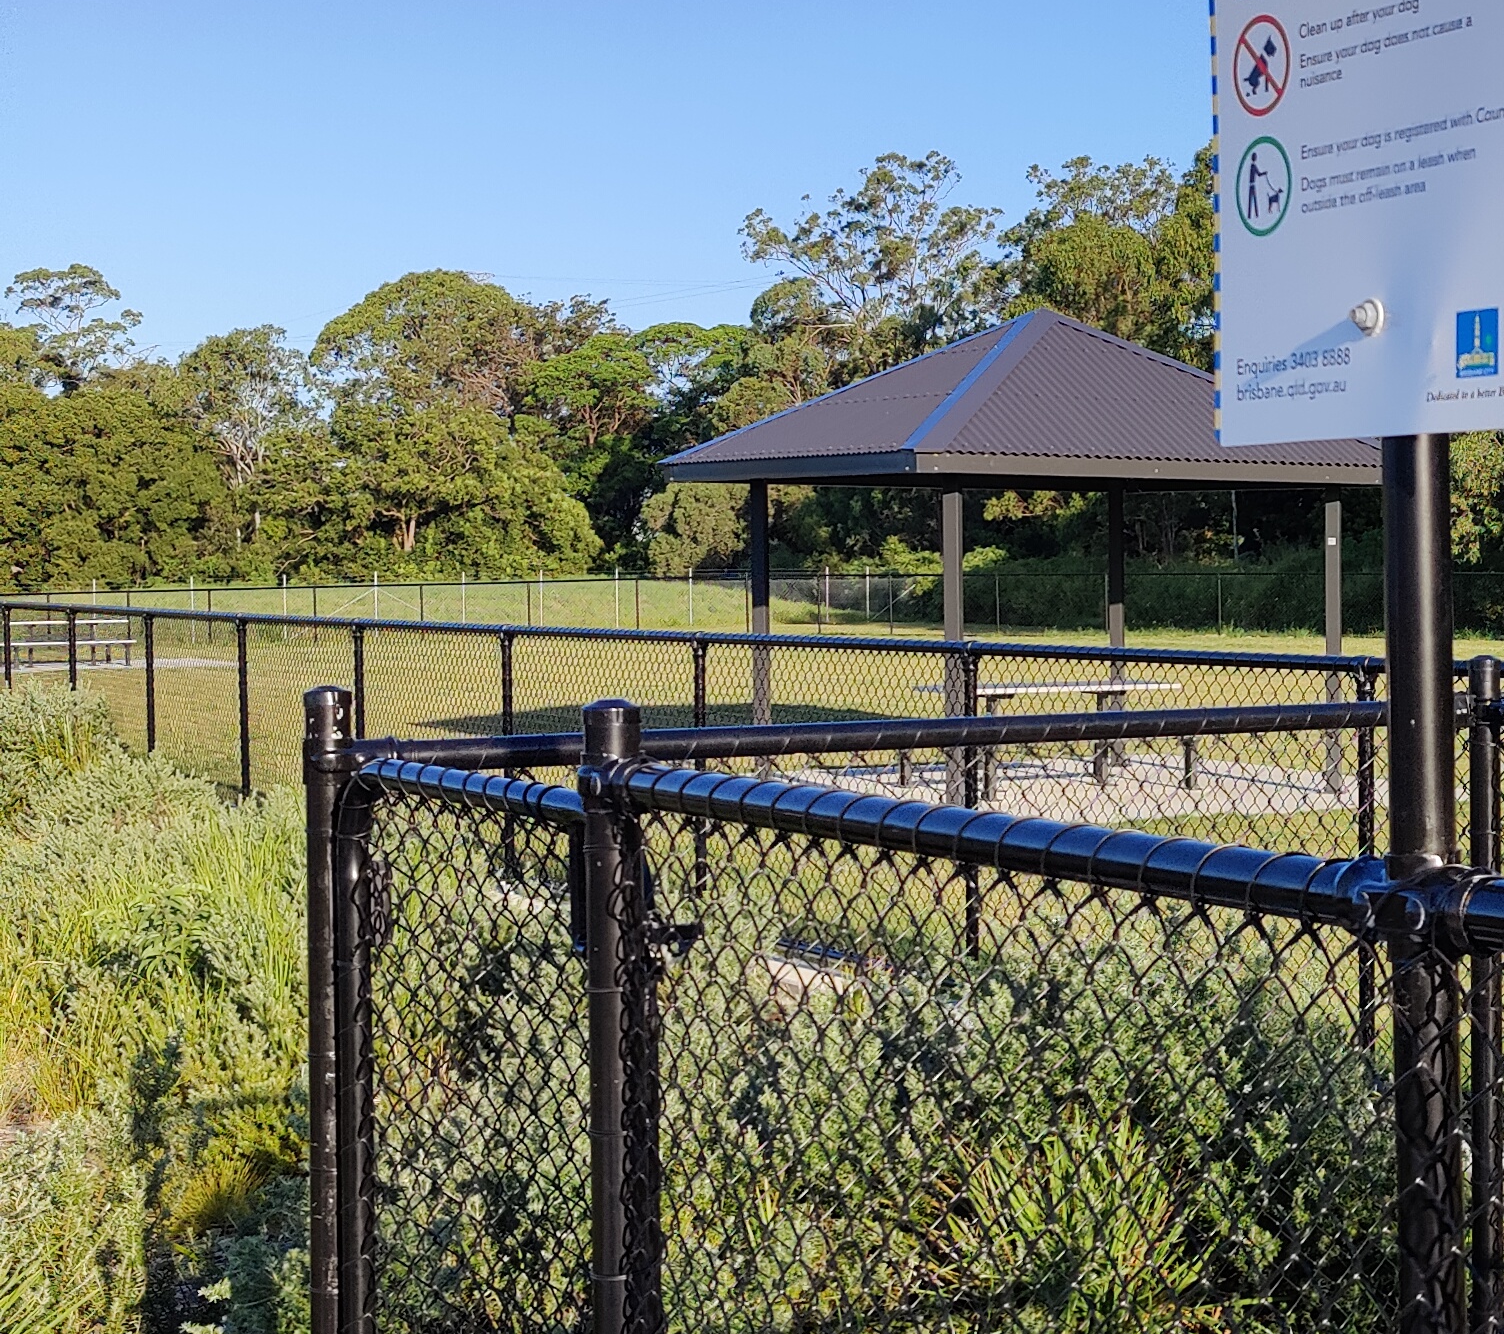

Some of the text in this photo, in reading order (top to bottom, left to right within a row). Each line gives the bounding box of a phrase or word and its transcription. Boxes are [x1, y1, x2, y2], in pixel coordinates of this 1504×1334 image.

[1299, 20, 1328, 39] Clean
[1329, 17, 1343, 33] up
[1345, 9, 1370, 28] after
[1371, 4, 1396, 24] your
[1299, 15, 1473, 69] Ensure your dog does not cause a
[1299, 68, 1343, 88] nuisance
[1301, 144, 1334, 160] Ensure
[1335, 138, 1359, 156] your
[1361, 132, 1382, 149] dog
[1383, 130, 1392, 143] is
[1394, 118, 1448, 143] registered
[1450, 112, 1473, 128] with
[1301, 147, 1476, 193] Dogs must remain on a leash when
[1301, 197, 1337, 214] outside
[1339, 193, 1356, 207] the
[1404, 181, 1426, 195] area
[1236, 346, 1351, 379] Enquiries 3403 8888
[1237, 379, 1347, 402] brisbane.qld.gov.au
